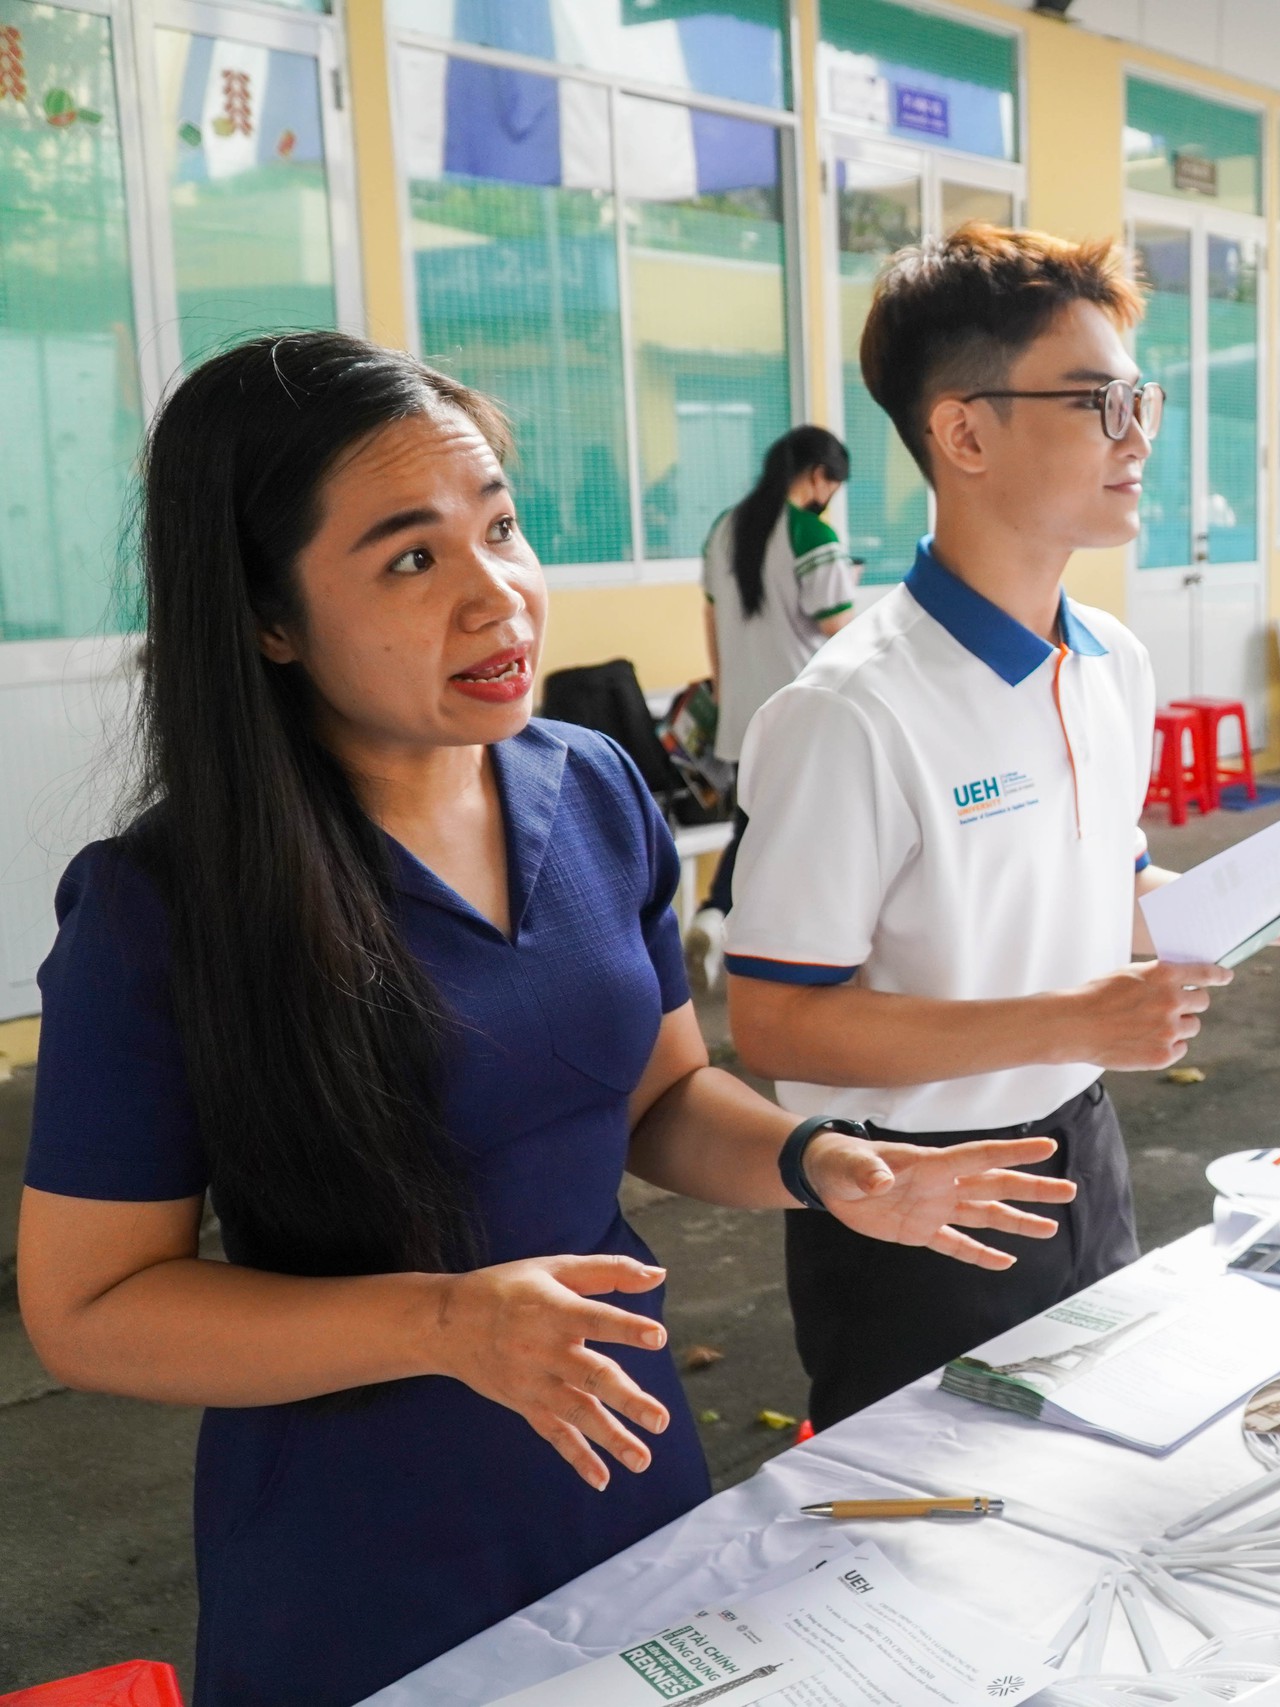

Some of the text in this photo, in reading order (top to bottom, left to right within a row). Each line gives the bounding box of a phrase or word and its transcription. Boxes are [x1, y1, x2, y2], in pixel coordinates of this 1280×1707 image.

[953, 776, 1000, 807] UEH
[956, 797, 1002, 817] UNIVERSITY
[844, 1569, 875, 1594] UEH
[668, 1637, 722, 1682] ỨNG DỤNG
[686, 1629, 710, 1648] TÀI
[703, 1645, 741, 1676] CHÍNH
[625, 1647, 686, 1697] RENNES
